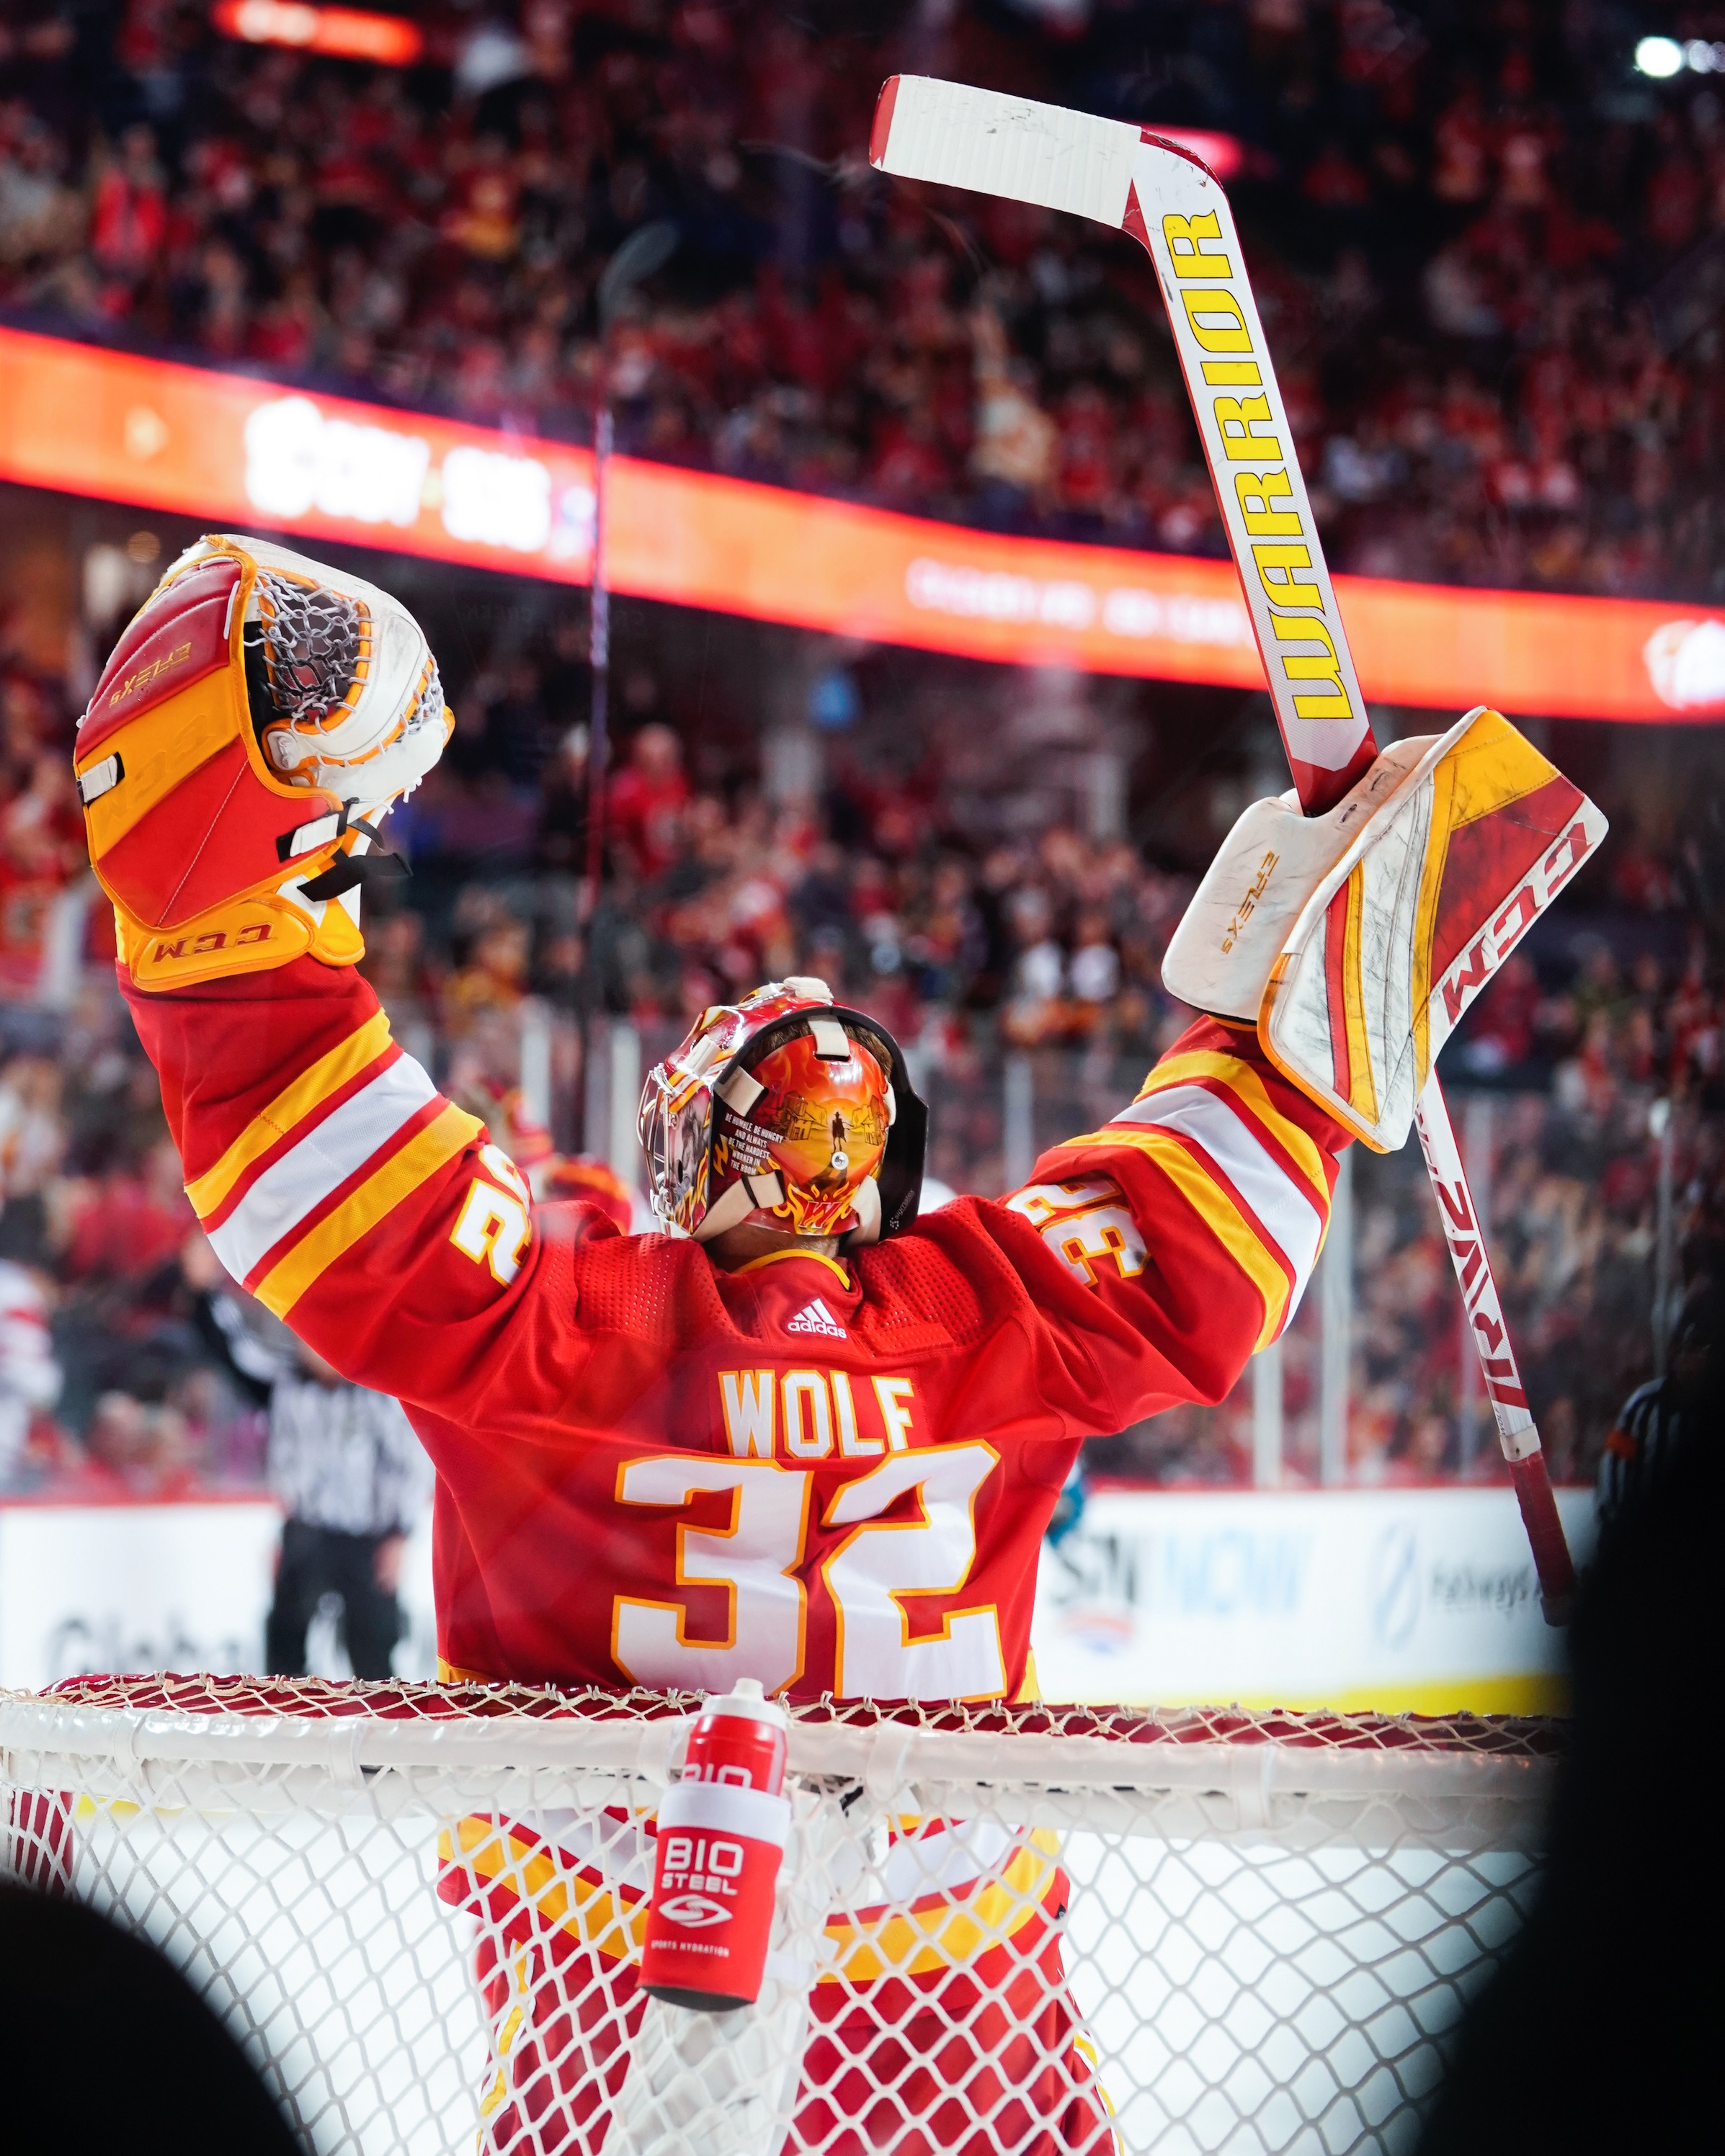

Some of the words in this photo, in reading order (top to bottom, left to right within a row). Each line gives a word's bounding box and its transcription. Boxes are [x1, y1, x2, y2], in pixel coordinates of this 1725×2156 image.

[1162, 209, 1354, 719] WARRIOR
[1442, 822, 1595, 1026] CCM
[153, 922, 274, 963] CCM
[725, 1113, 733, 1123] BE
[731, 1116, 753, 1132] HUMBLE
[753, 1125, 762, 1135] BE
[761, 1128, 784, 1143] HUNGRY
[735, 1129, 746, 1140] AND
[746, 1134, 767, 1148] ALWAYS
[728, 1137, 736, 1146] BE
[736, 1140, 746, 1151] THE
[745, 1144, 770, 1160] HARDEST
[732, 1150, 754, 1166] WORKER
[753, 1158, 761, 1166] IN
[731, 1159, 741, 1171] THE
[740, 1164, 757, 1176] ROOM
[788, 1320, 847, 1339] adidas
[718, 1369, 914, 1459] WOLF
[611, 1438, 1007, 1702] 32
[664, 1838, 744, 1877] BIO
[661, 1873, 738, 1896] STEEL
[651, 1939, 677, 1950] SPORTS
[679, 1942, 730, 1958] HYDRATION
